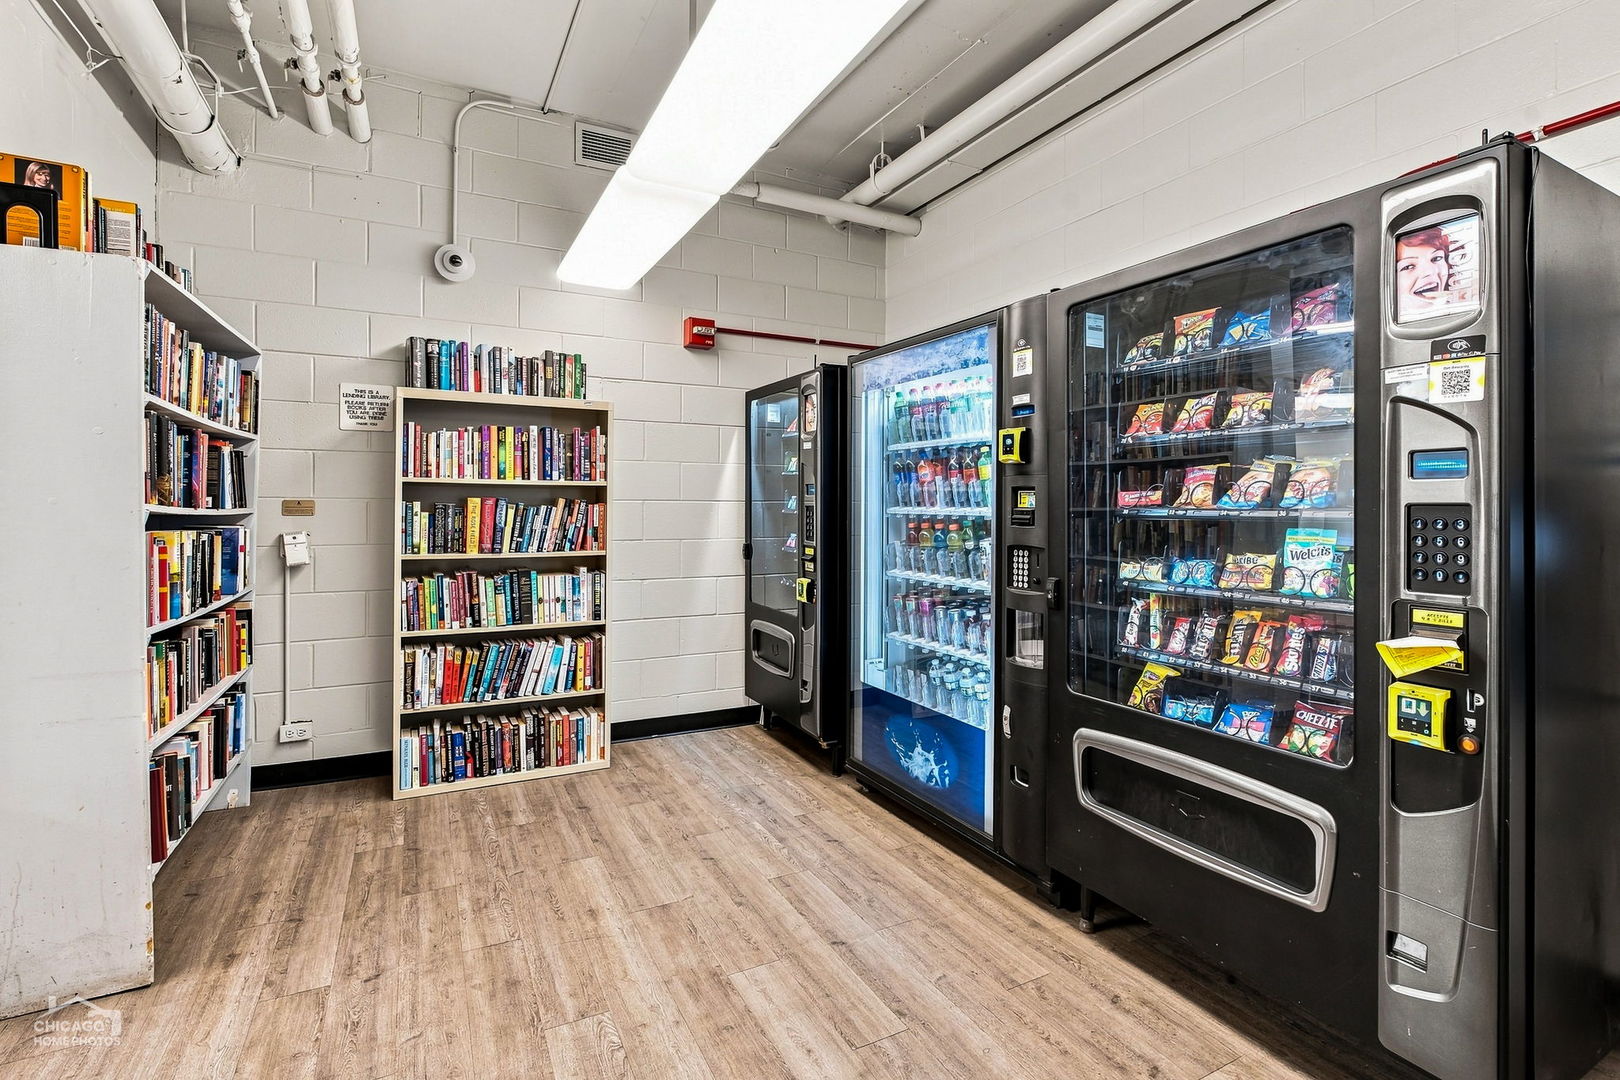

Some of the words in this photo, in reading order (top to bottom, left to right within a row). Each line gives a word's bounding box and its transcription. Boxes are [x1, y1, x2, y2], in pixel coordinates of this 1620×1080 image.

[1416, 520, 1421, 528] 1
[1436, 520, 1443, 528] 2
[1457, 520, 1464, 529] 3
[1416, 536, 1422, 545] 4
[1436, 537, 1443, 547] 5
[1457, 537, 1464, 547] 6
[1417, 554, 1422, 562] 7
[1437, 554, 1443, 563] 8
[1457, 555, 1464, 563] 9
[1436, 571, 1442, 581] 0
